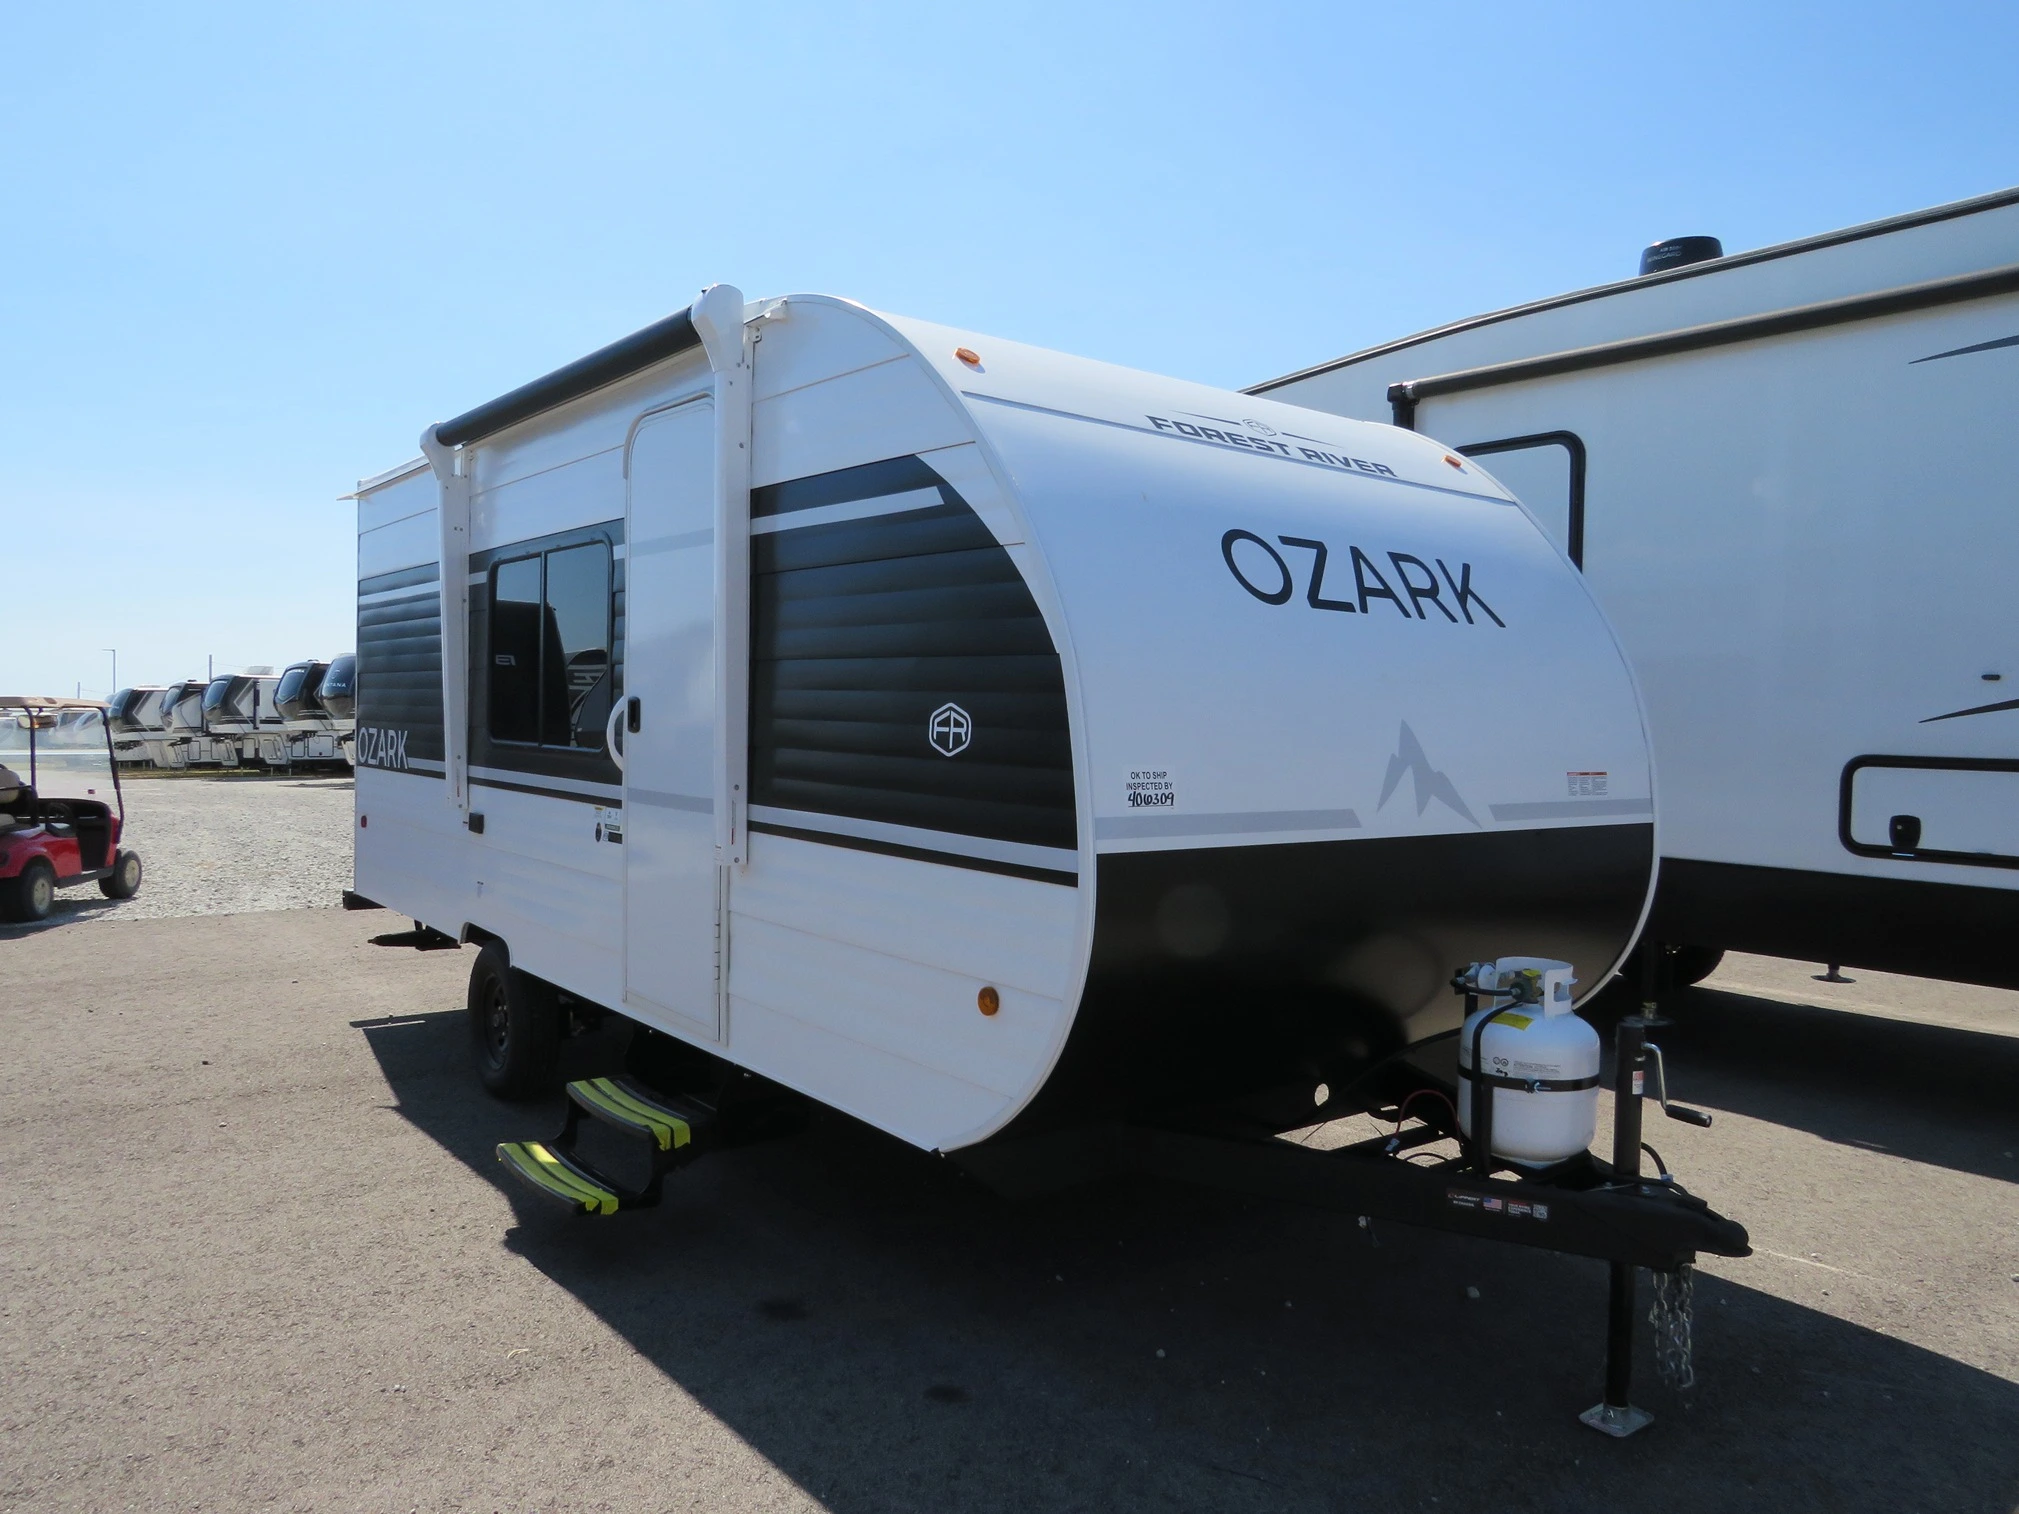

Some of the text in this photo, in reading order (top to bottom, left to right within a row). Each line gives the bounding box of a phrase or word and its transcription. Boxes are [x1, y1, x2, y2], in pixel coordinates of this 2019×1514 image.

[1144, 414, 1399, 478] FOREST RIVER
[1221, 528, 1506, 628] OZARK
[357, 726, 408, 769] OZARK
[1126, 782, 1173, 791] INSPECTED BY
[1130, 771, 1167, 780] OK TO SHIP
[1128, 791, 1175, 807] 406309
